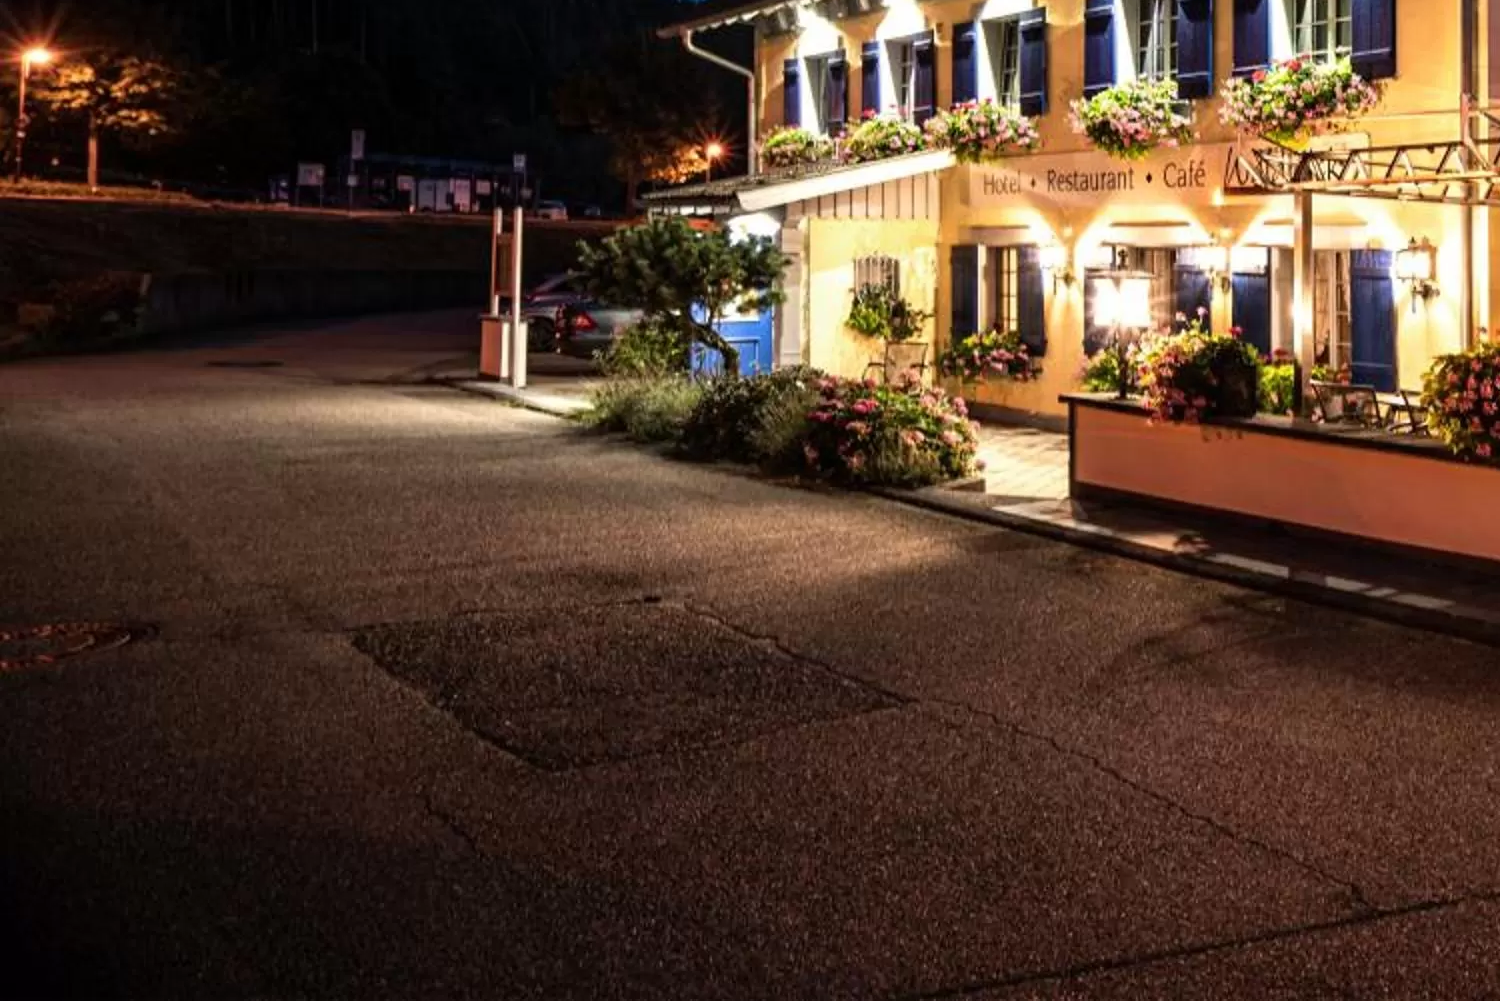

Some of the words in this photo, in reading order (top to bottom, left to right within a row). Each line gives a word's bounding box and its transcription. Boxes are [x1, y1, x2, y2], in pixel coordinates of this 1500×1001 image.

[983, 171, 1021, 196] Hotel
[1046, 167, 1134, 192] Restaurant
[1163, 160, 1206, 188] Café
